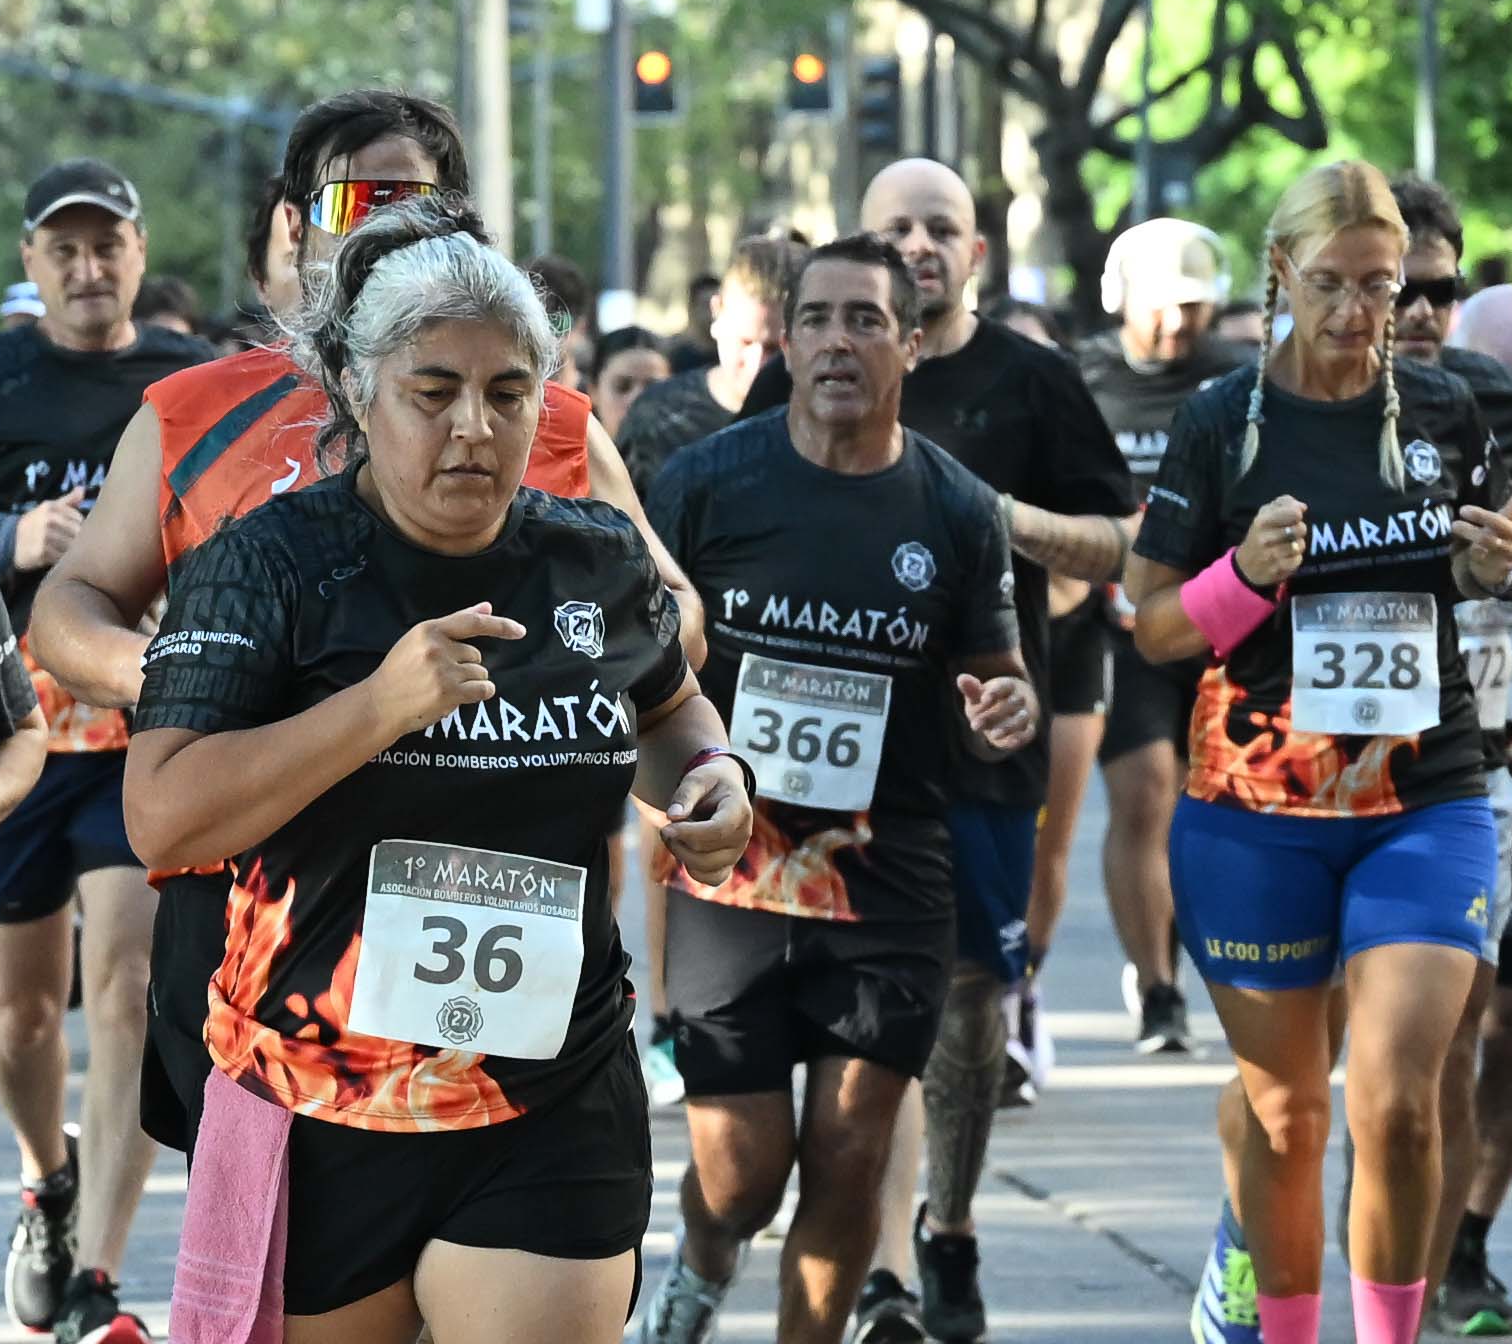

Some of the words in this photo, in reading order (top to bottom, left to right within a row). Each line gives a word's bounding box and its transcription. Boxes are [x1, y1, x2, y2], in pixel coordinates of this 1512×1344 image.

[1310, 498, 1452, 556] MARATÓN
[760, 593, 929, 651] MARATÓN
[1337, 601, 1419, 621] MARATÓN
[191, 630, 256, 650] MUNICIPAL
[1311, 642, 1421, 690] 328
[782, 674, 871, 702] MARATÓN
[747, 707, 861, 768] 366
[436, 753, 519, 769] BOMBEROS
[520, 750, 610, 769] VOLUNTARIOS
[404, 856, 426, 880] 1º
[433, 859, 556, 900] MARATÓN
[433, 889, 483, 905] BOMBEROS
[484, 895, 539, 913] VOLUNTARIOS
[540, 904, 577, 919] ROSARIO
[413, 915, 524, 994] 36
[451, 1010, 471, 1027] 27
